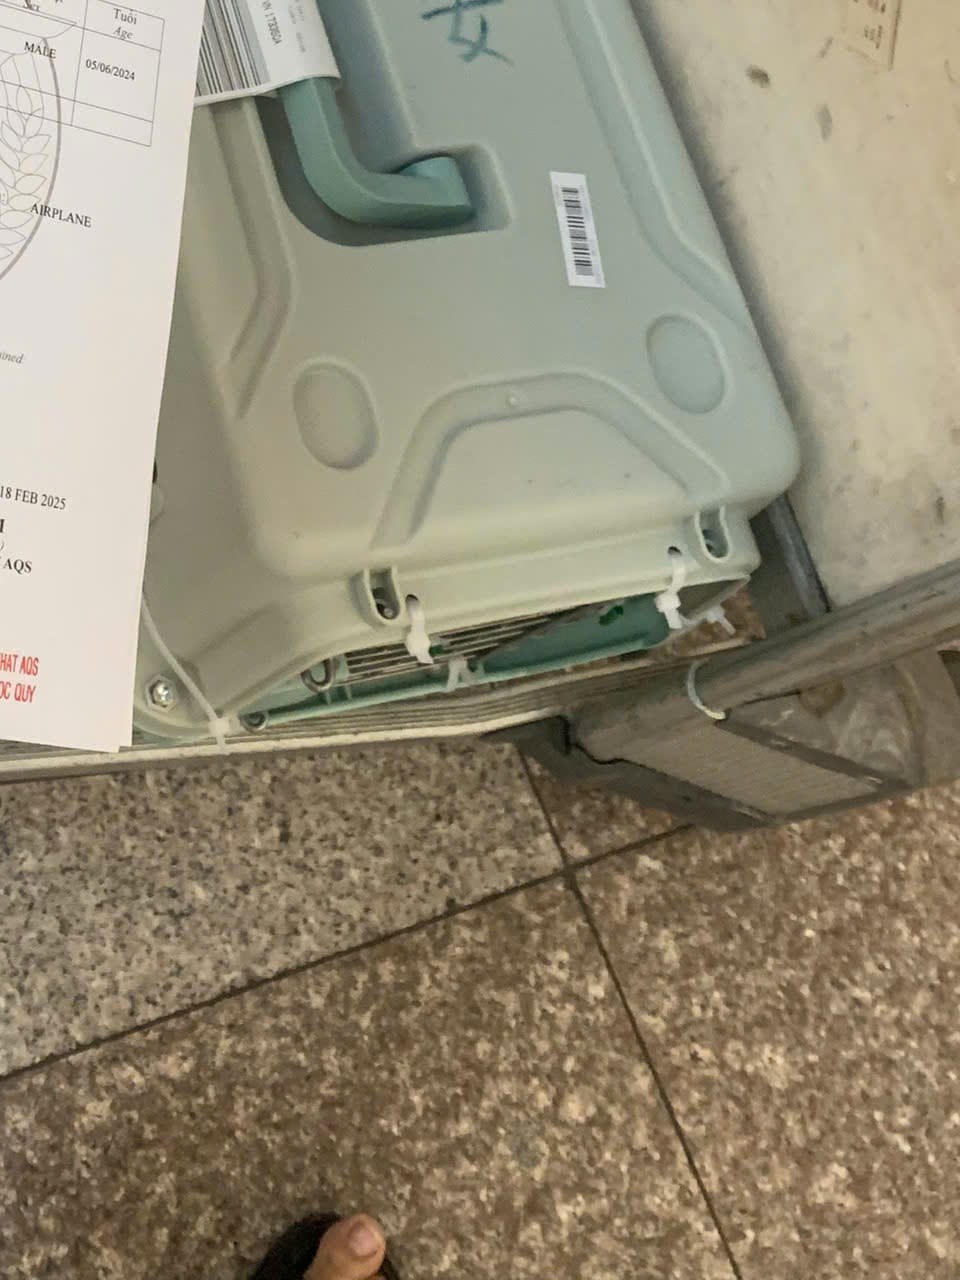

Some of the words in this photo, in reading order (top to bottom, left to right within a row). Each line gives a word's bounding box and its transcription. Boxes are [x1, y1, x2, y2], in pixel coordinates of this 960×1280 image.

[113, 26, 133, 40] Age
[24, 41, 57, 59] MALE
[85, 58, 135, 81] 05/06/2024
[30, 202, 92, 228] AIRPLANE
[14, 488, 38, 505] FEB
[40, 493, 67, 511] 2025
[3, 558, 33, 574] AQS
[19, 655, 39, 676] AQS
[14, 683, 36, 703] QUY
